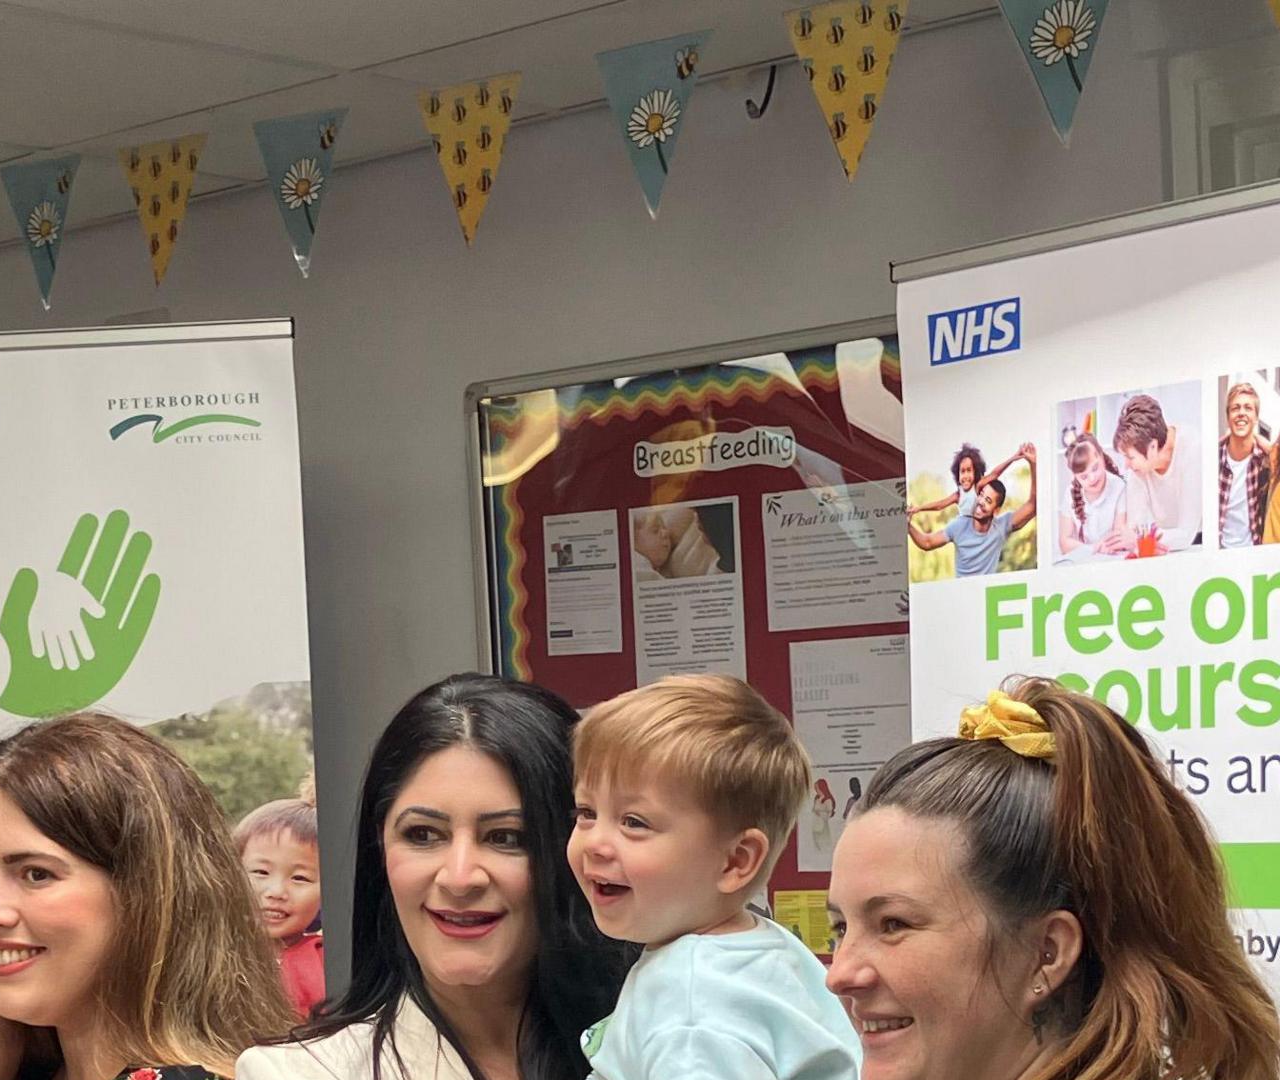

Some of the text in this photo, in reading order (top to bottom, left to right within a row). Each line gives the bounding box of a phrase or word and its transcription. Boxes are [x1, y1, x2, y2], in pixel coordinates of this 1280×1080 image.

[932, 302, 1019, 364] NHS
[107, 392, 261, 412] PETERBOROUGH
[175, 432, 263, 445] CITY COUNCIL
[635, 428, 794, 472] Breastfeeding
[780, 510, 826, 529] What's
[847, 506, 871, 521] this
[873, 502, 907, 519] week
[984, 583, 1166, 661] Free
